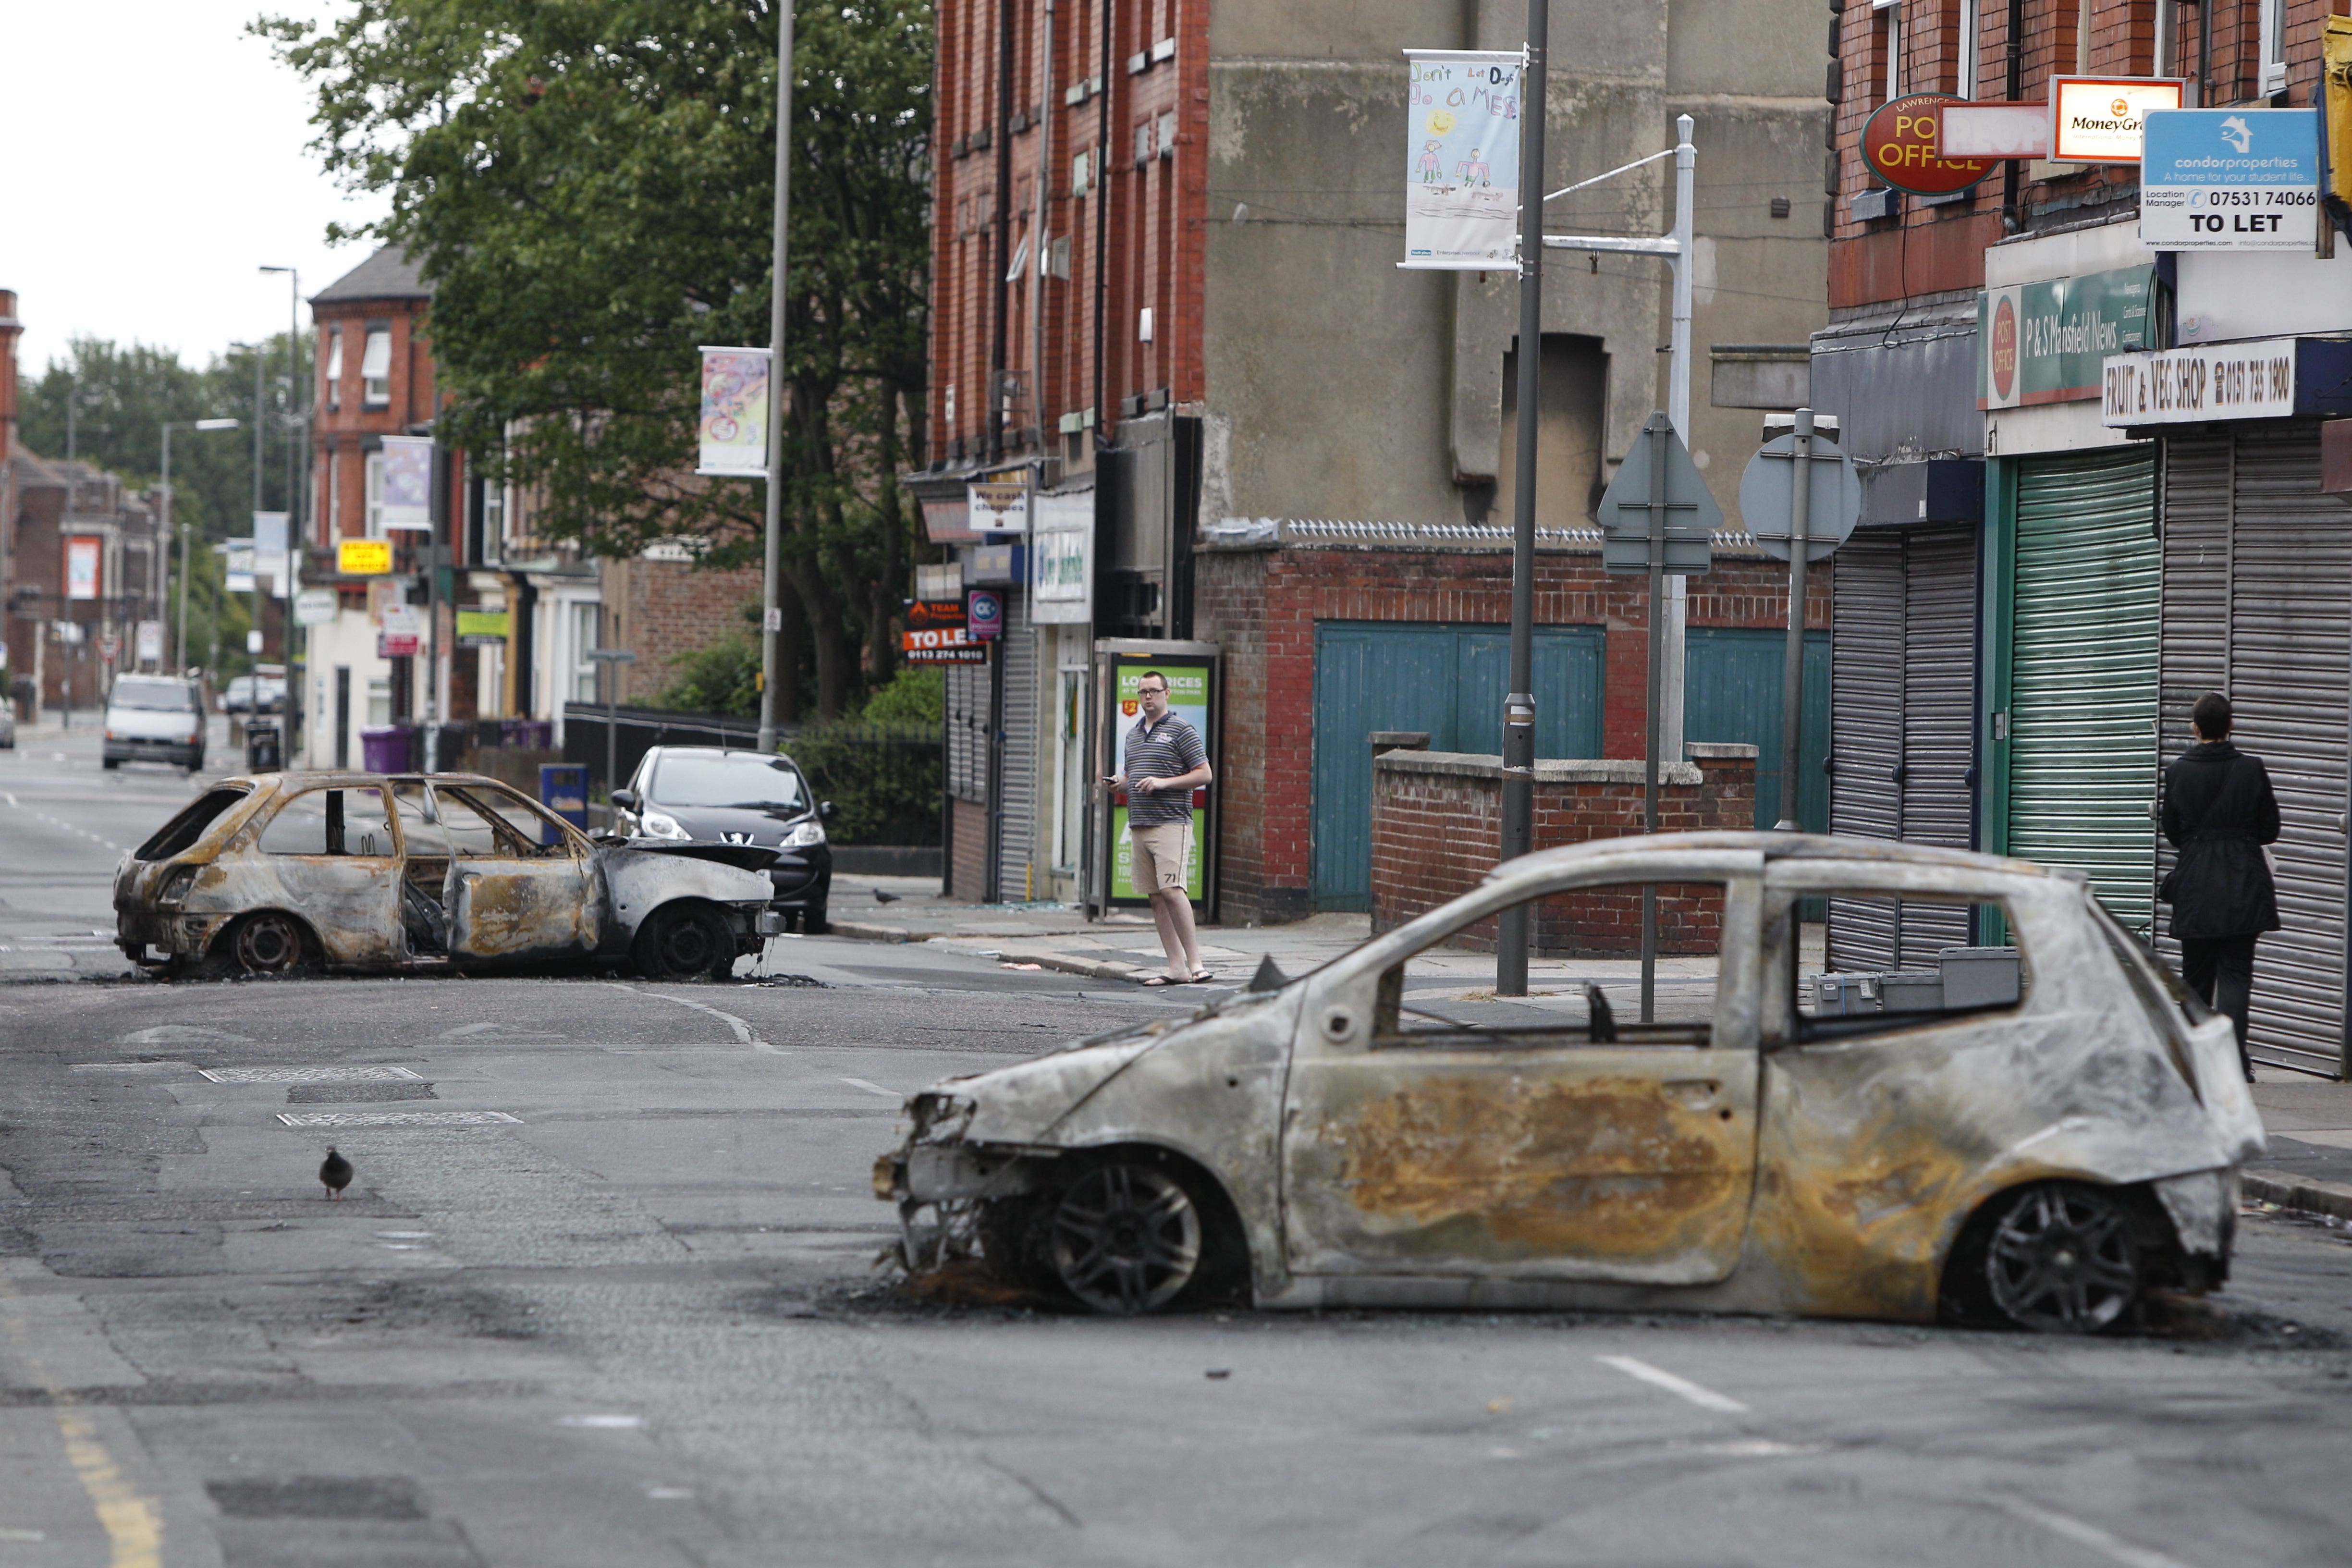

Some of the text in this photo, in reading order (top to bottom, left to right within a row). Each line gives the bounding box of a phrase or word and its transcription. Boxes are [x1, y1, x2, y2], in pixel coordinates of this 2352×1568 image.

[1409, 62, 1514, 86] Don't Let Dogs
[1409, 82, 1433, 105] Do
[1896, 116, 1936, 139] PO
[2175, 155, 2298, 171] condorproperties
[2164, 172, 2172, 181] A
[2175, 172, 2205, 181] home
[2209, 172, 2221, 181] for
[2225, 174, 2245, 183] your
[2249, 173, 2287, 181] student
[2146, 199, 2185, 208] Manager
[2190, 214, 2283, 233] TO LET
[1997, 320, 2011, 343] POST
[2026, 310, 2117, 358] P & S Mansfield News
[1995, 348, 2013, 373] OFFICE
[2106, 365, 2135, 416] FRUIT
[2139, 371, 2147, 414] &
[2151, 358, 2172, 412] VEG
[2177, 357, 2206, 411] SHOP
[2227, 360, 2245, 406] 0151
[2269, 356, 2290, 403] 1900
[996, 491, 1024, 499] cash
[975, 503, 1024, 513] cheques
[930, 603, 959, 612] TEAM
[909, 628, 967, 648] TO LE
[1122, 676, 1202, 687] LO RICES
[1124, 701, 1137, 713] £2
[1164, 873, 1176, 883] 71
